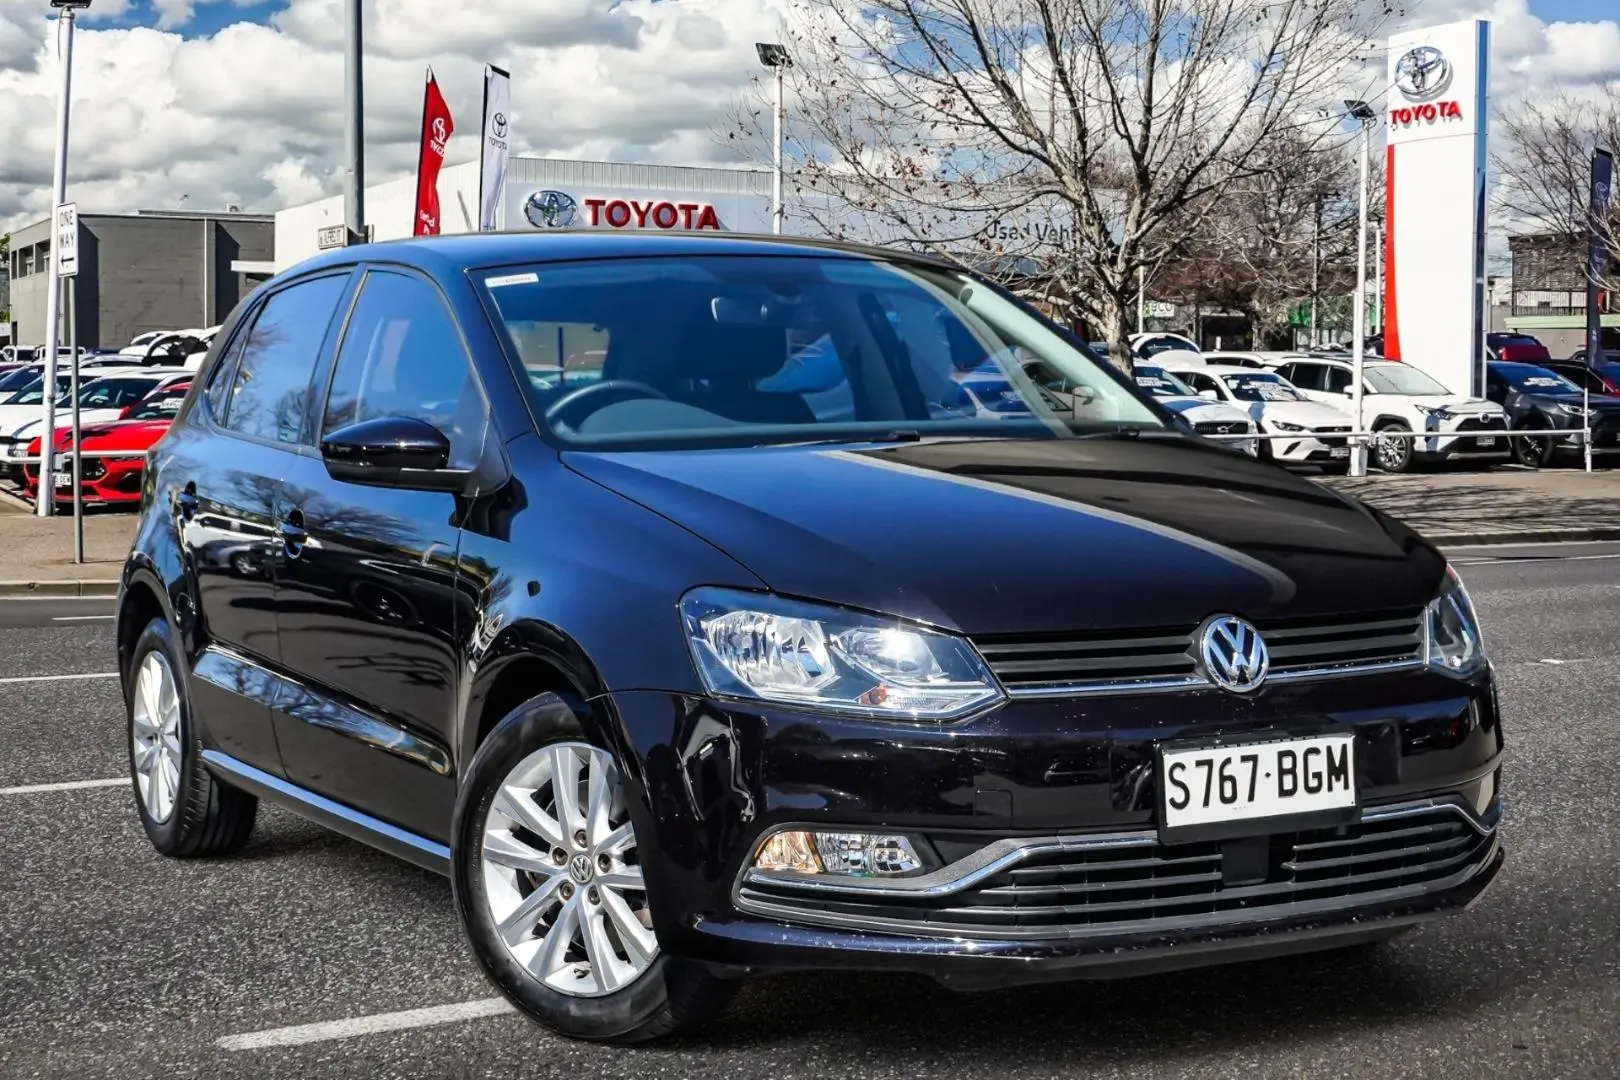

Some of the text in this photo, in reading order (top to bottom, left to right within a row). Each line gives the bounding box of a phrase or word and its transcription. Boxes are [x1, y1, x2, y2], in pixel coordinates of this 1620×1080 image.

[1390, 101, 1462, 124] TOYOTA
[60, 209, 74, 227] ONE
[584, 199, 720, 230] TOYOTA
[59, 231, 75, 249] WAY
